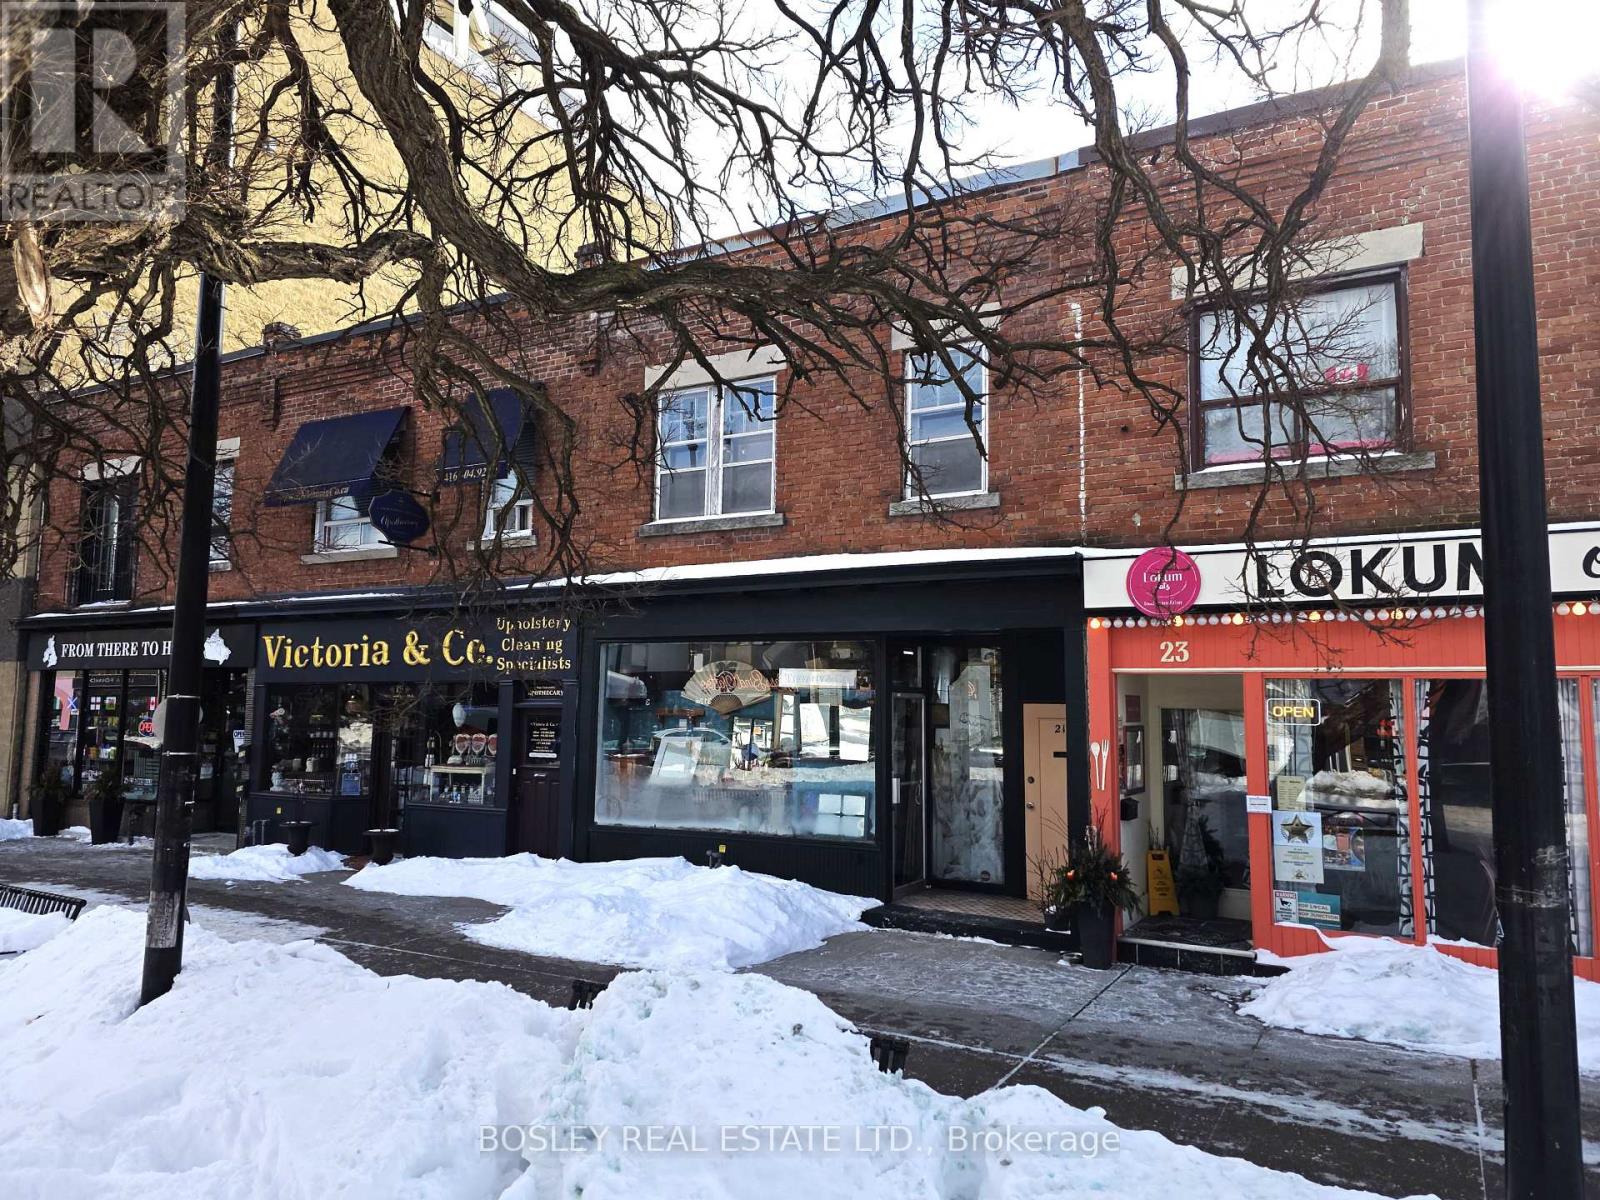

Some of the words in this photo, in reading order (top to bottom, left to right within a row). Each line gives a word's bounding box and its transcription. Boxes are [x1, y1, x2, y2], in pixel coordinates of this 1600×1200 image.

[61, 643, 94, 658] FROM
[97, 641, 138, 657] THERE
[141, 640, 159, 656] TO
[262, 634, 390, 668] Victoria
[403, 630, 431, 666] &
[442, 629, 493, 666] Co.
[501, 636, 563, 654] Cleanng
[1160, 641, 1190, 663] 23
[1273, 706, 1314, 718] OPEN
